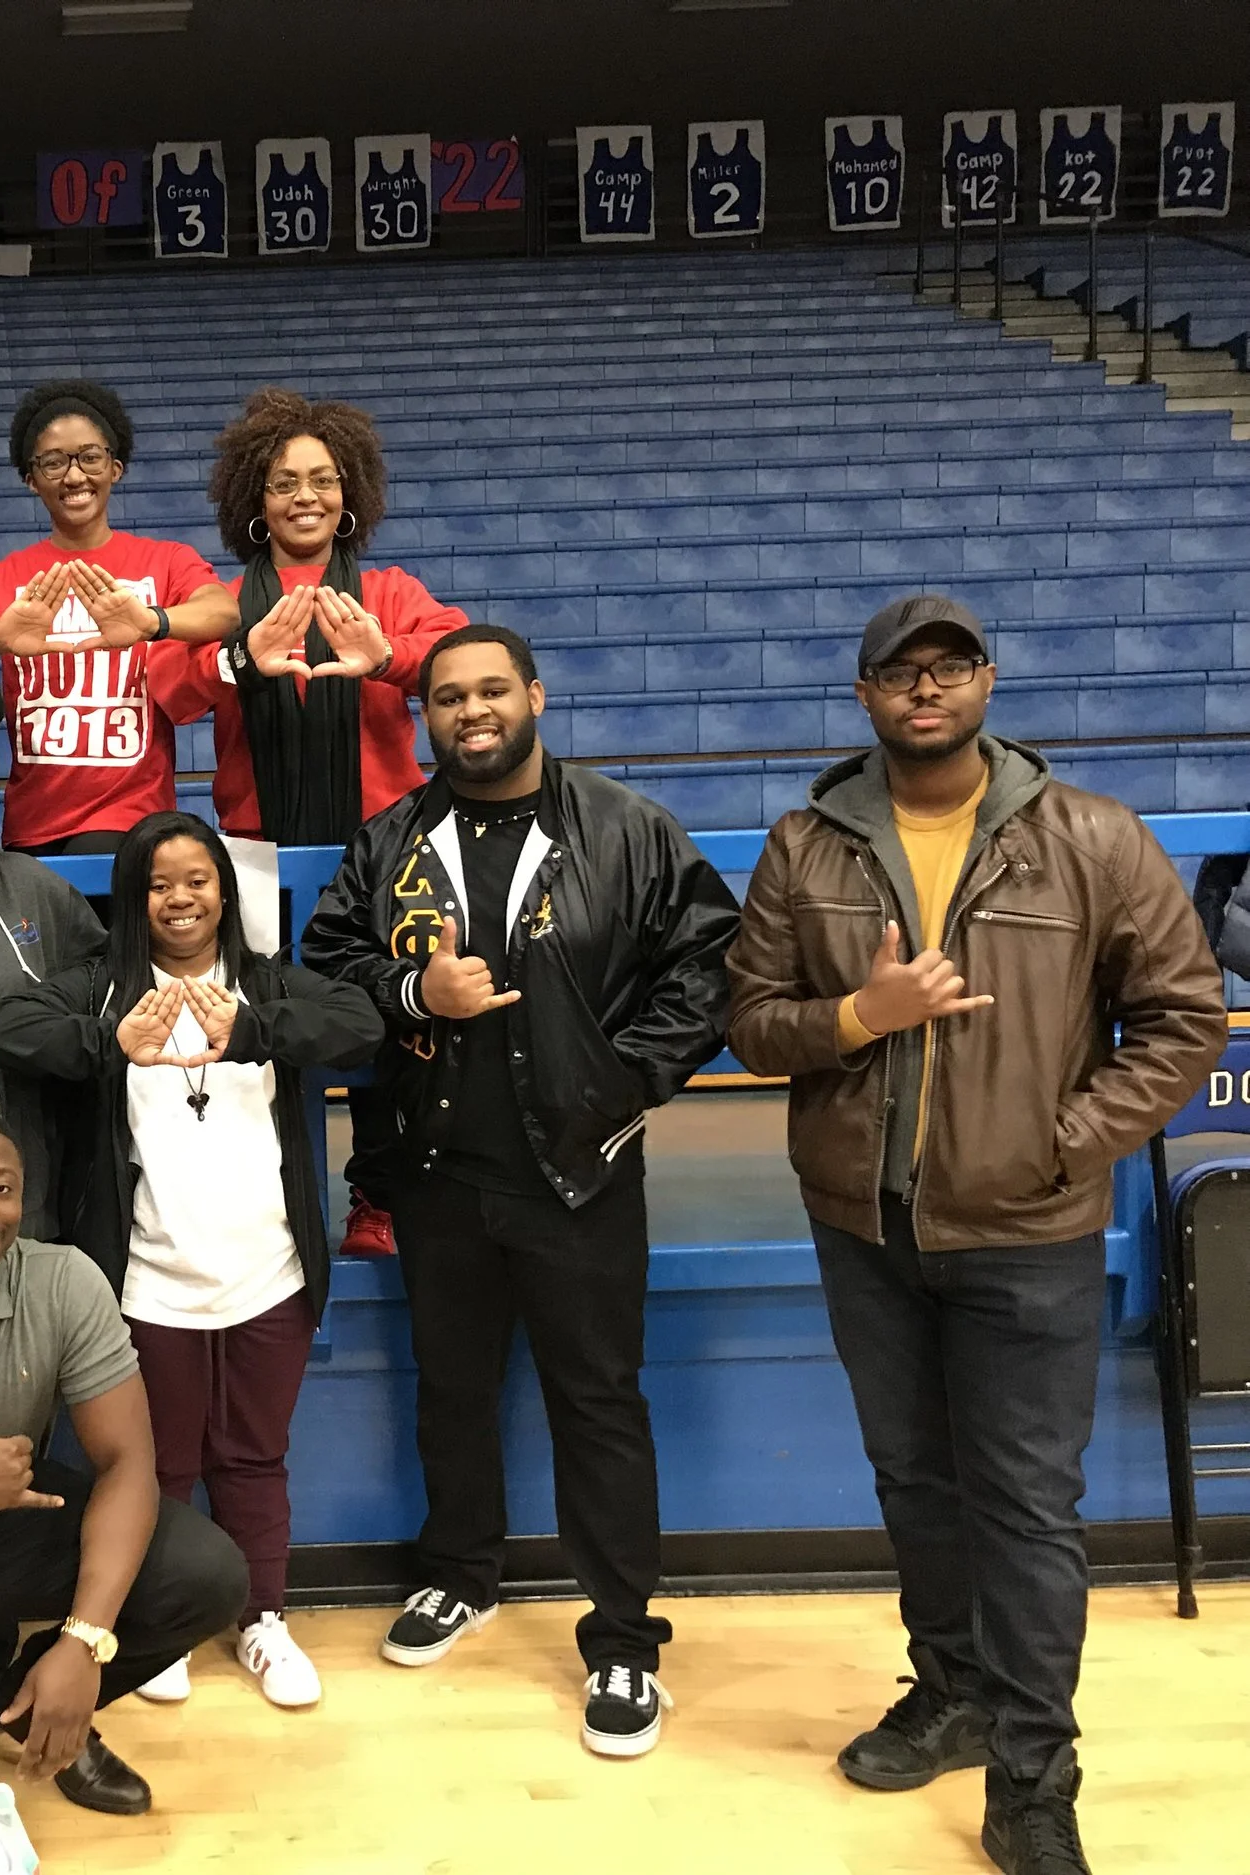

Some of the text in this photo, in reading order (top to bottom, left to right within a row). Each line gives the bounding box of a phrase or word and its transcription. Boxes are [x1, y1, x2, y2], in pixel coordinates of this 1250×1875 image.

[595, 169, 642, 189] Camp
[697, 163, 741, 181] Miller
[956, 152, 1003, 173] Camp
[167, 184, 210, 199] Green
[845, 176, 889, 215] 10
[961, 175, 999, 211] 42
[1056, 170, 1103, 207] 22
[1176, 166, 1215, 197] 22
[369, 201, 418, 240] 30
[599, 191, 635, 223] 44
[709, 182, 740, 225] 2
[177, 204, 206, 247] 3
[271, 206, 316, 242] 30
[22, 706, 142, 758] 1913
